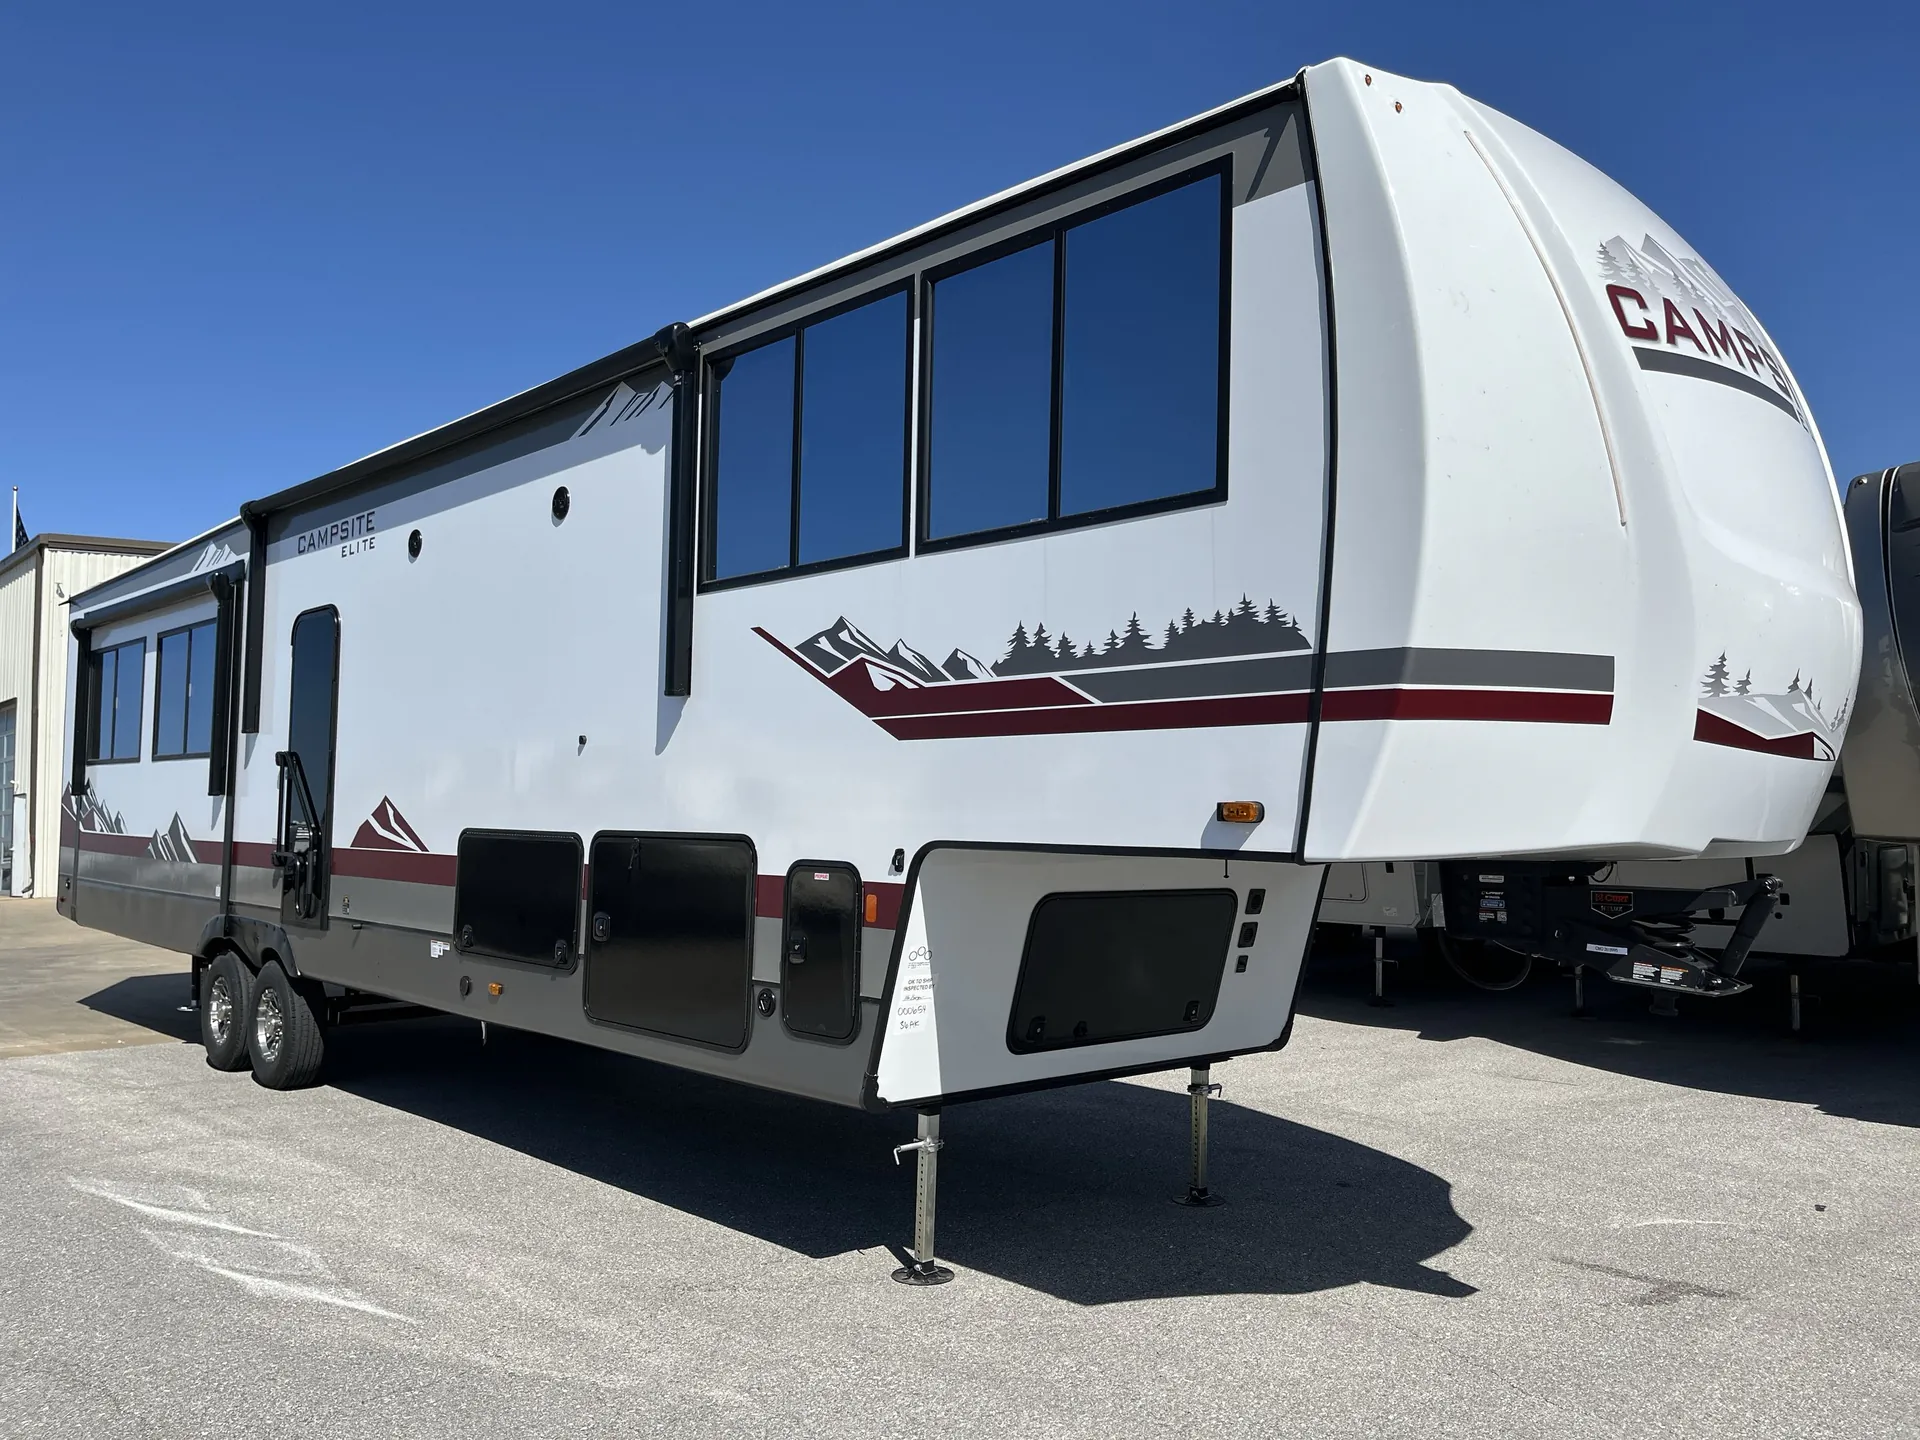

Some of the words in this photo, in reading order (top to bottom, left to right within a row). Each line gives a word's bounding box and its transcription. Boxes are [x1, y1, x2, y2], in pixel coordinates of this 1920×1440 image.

[1605, 283, 1798, 405] CAMPS
[297, 511, 376, 555] CAMPSITE
[341, 536, 376, 558] ELITE
